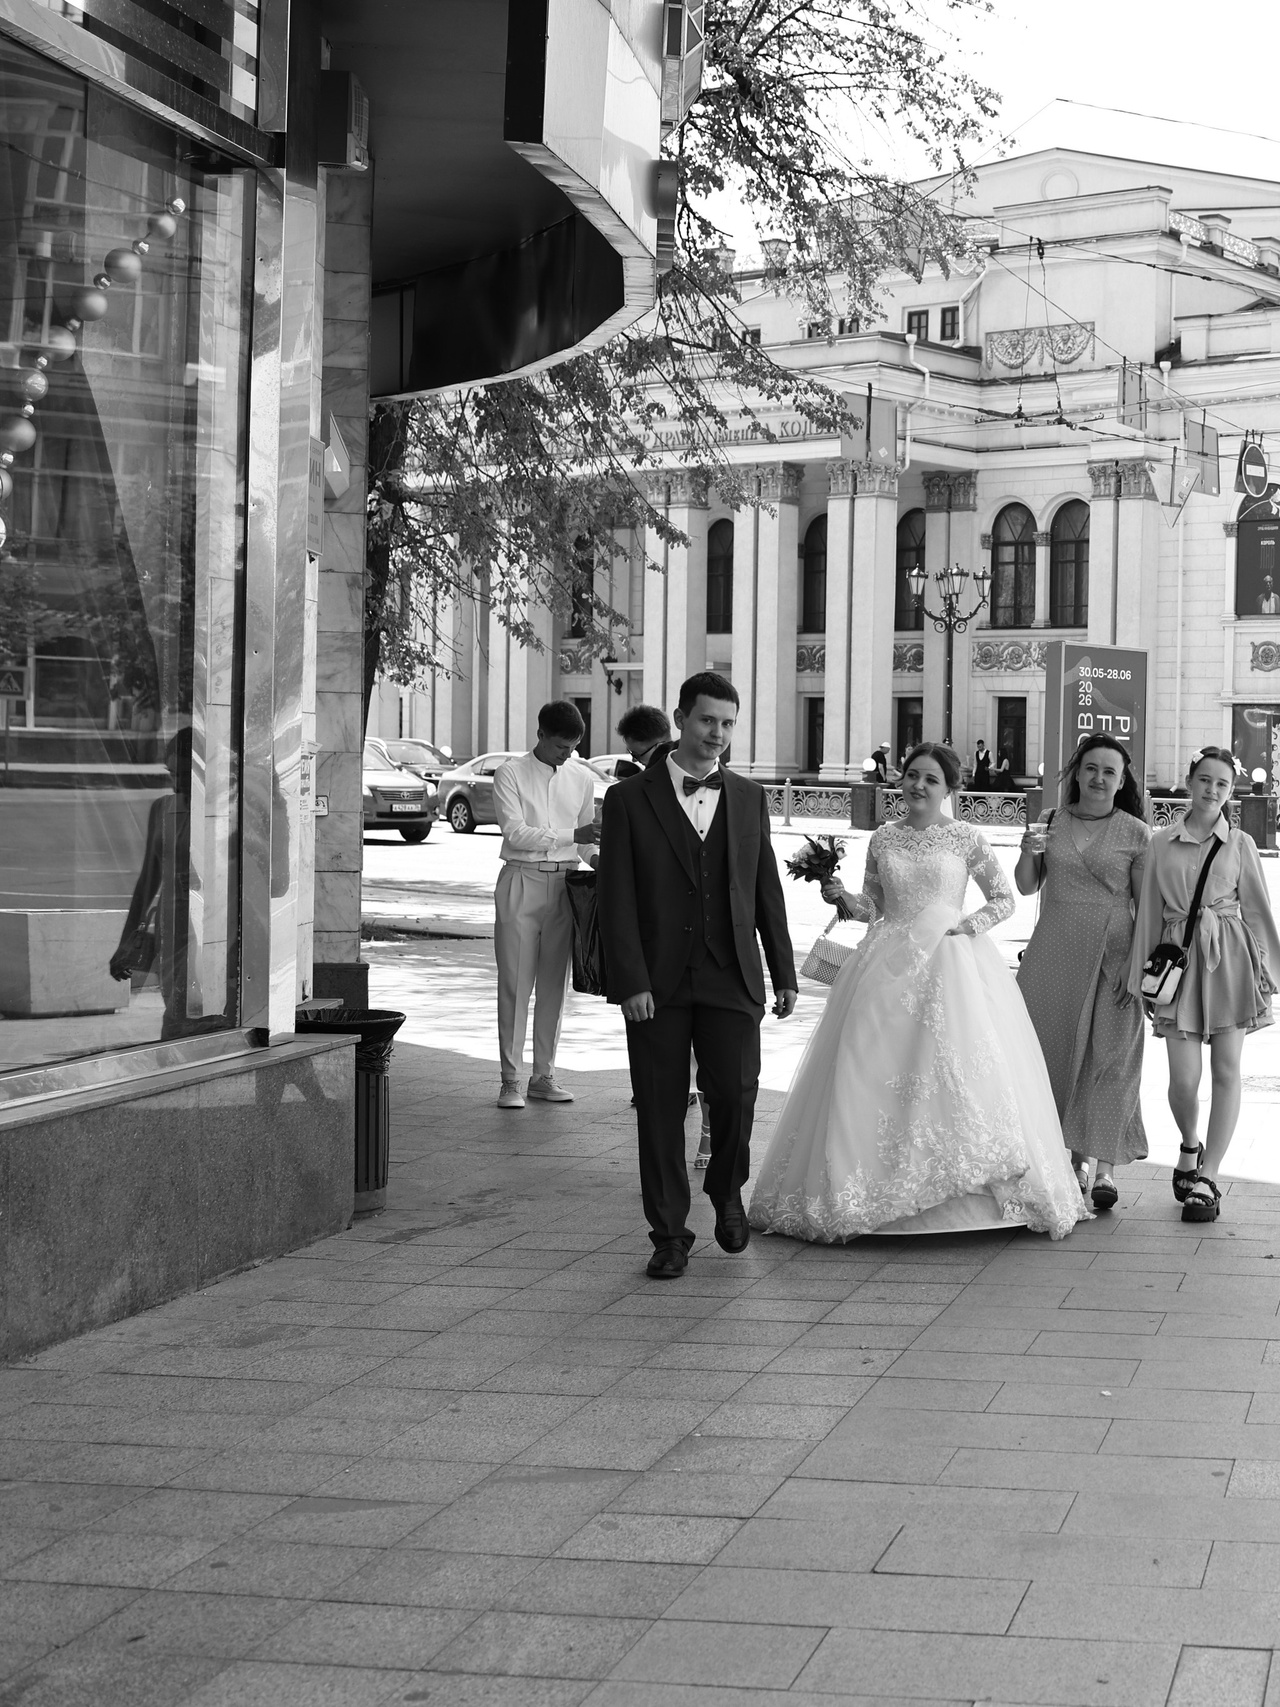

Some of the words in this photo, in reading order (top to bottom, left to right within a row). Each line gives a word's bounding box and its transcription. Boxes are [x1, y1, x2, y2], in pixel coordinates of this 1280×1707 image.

[1078, 666, 1132, 680] 30.05-28.06
[1078, 681, 1093, 693] 20
[1078, 693, 1092, 706] 26
